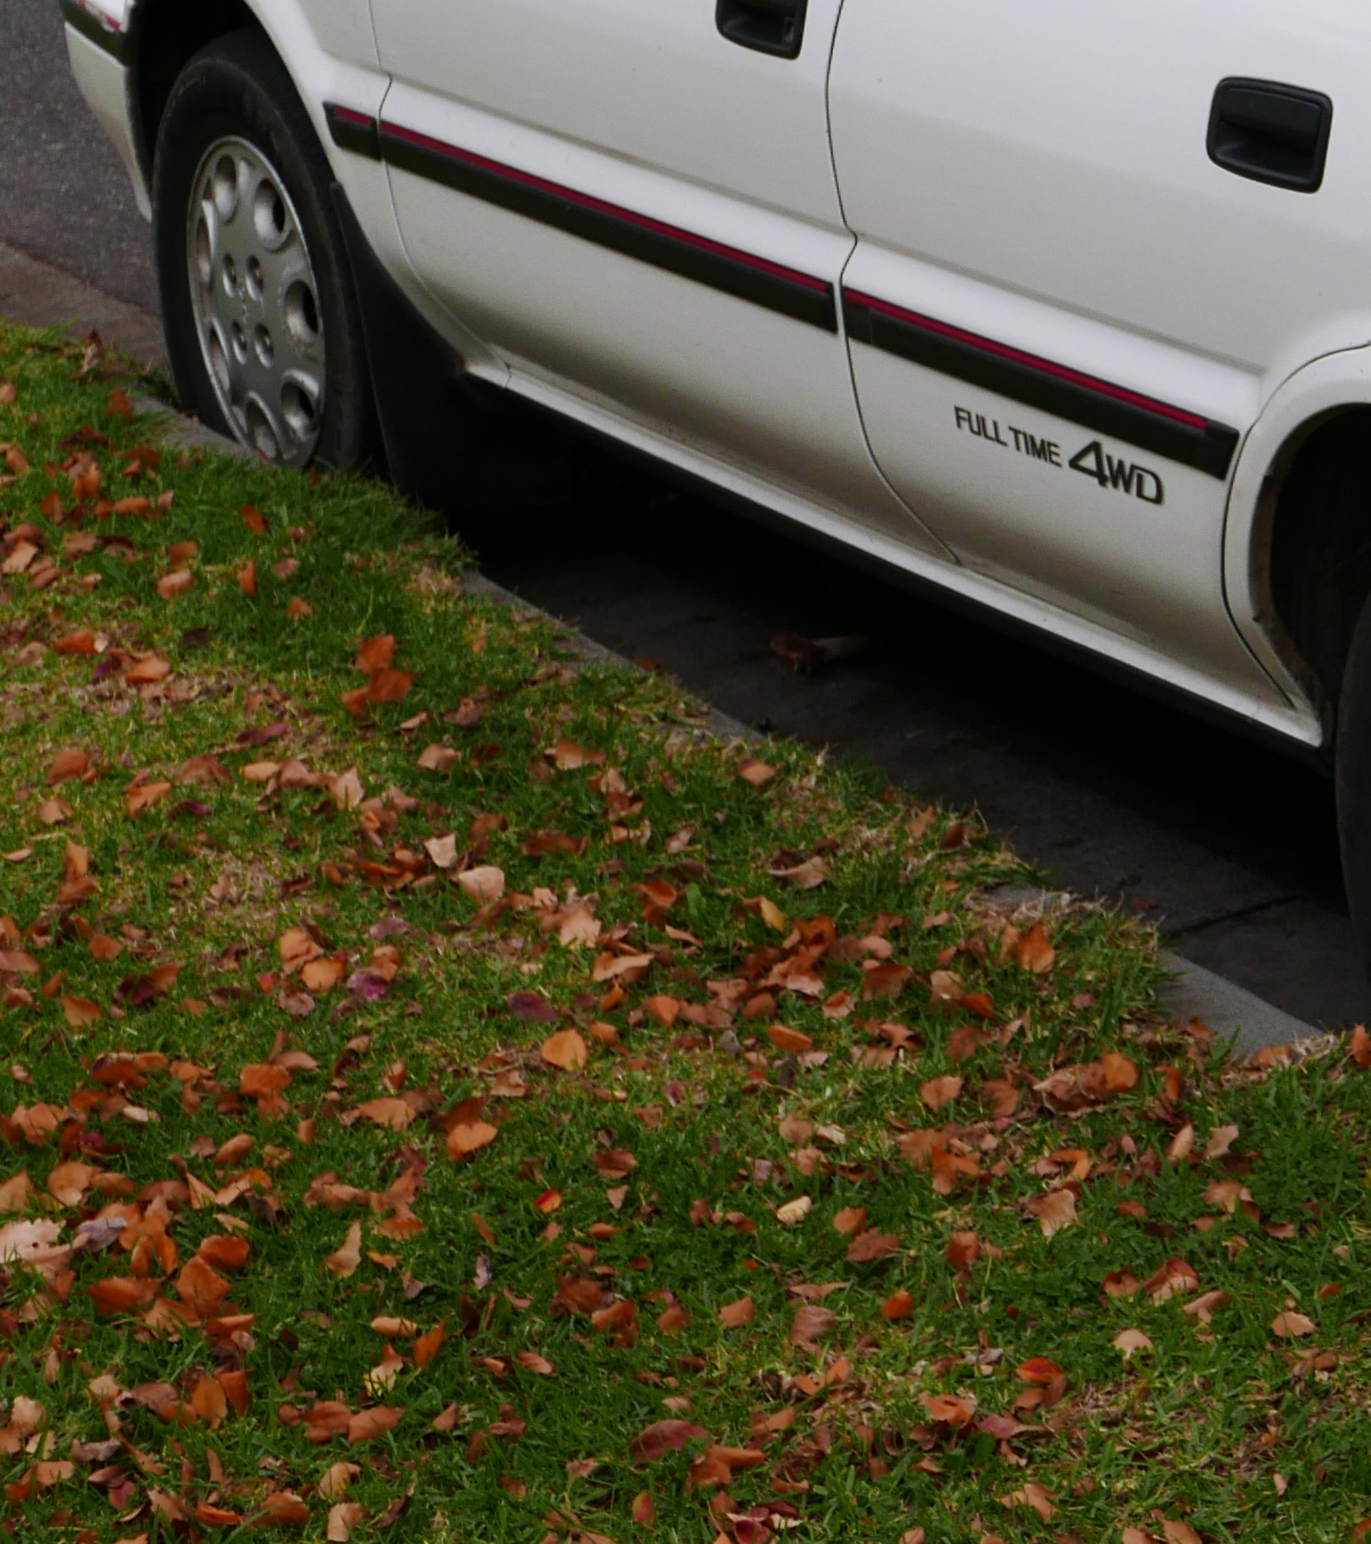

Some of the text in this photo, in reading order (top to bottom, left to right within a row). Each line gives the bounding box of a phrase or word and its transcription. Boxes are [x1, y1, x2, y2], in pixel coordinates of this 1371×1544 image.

[954, 404, 1165, 507] FULL TIME 4WD
